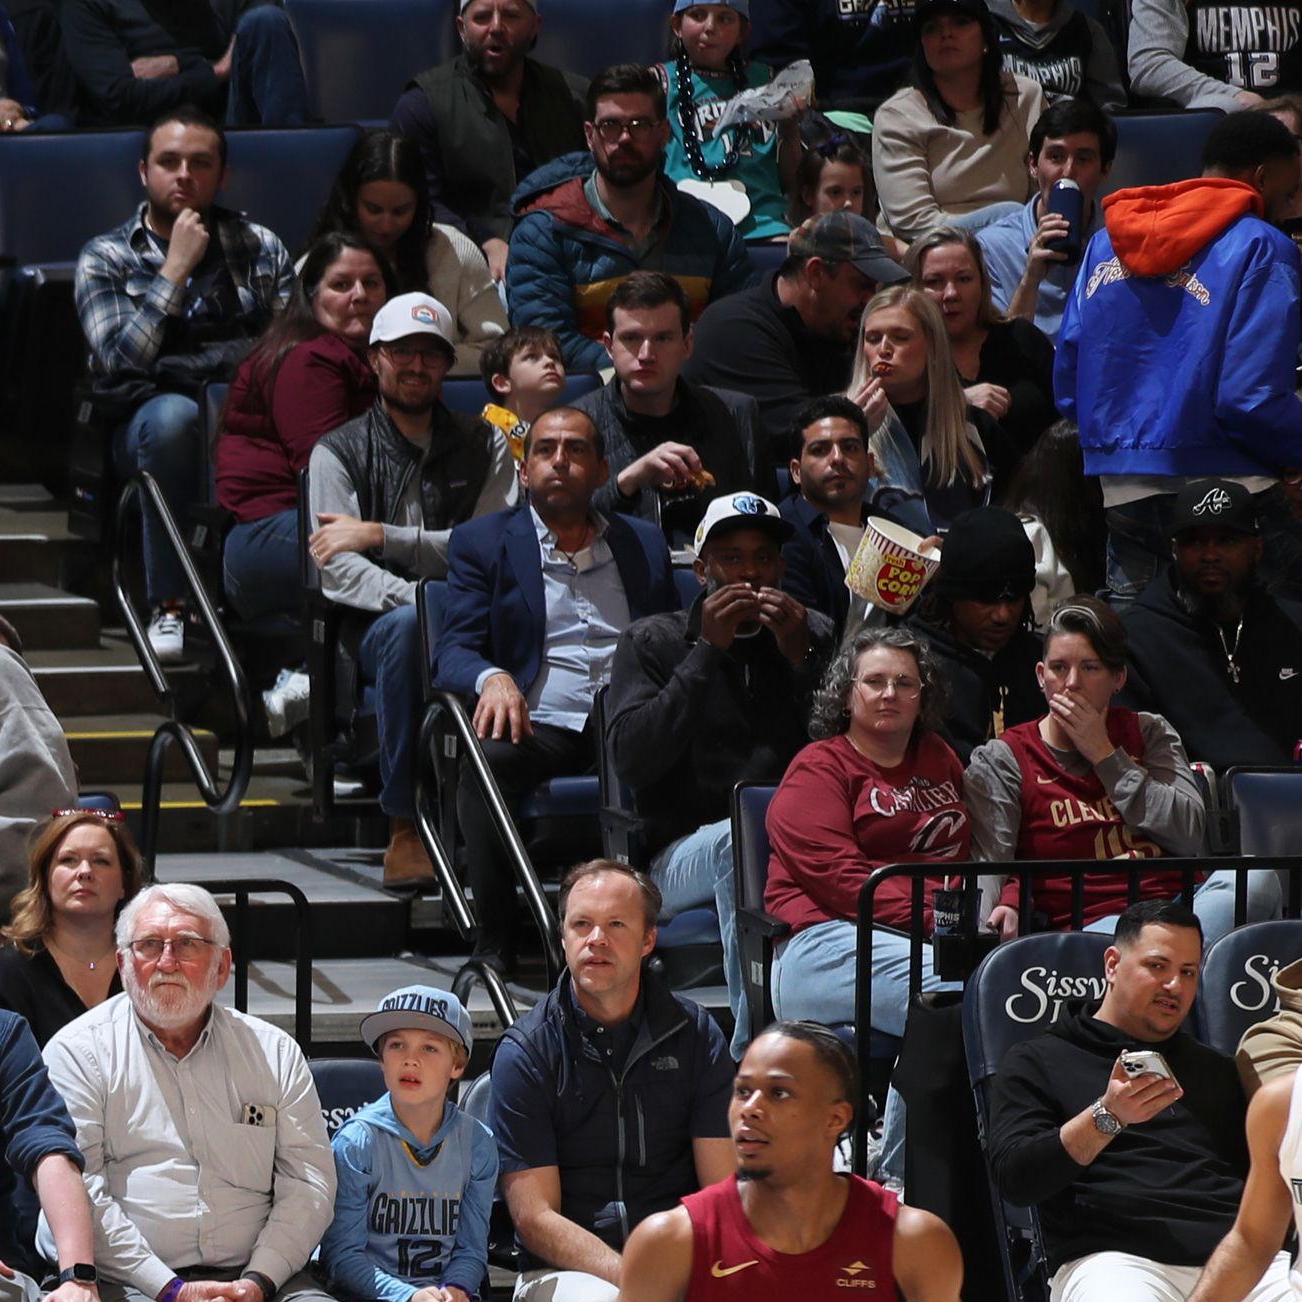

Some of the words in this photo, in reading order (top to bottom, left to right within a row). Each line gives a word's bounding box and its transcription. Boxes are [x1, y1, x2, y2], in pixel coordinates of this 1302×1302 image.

[1197, 7, 1300, 52] MEMPHIS
[1225, 52, 1279, 88] 12
[877, 579, 920, 597] CORN
[888, 567, 921, 583] POP
[396, 1238, 444, 1278] 12
[836, 1277, 876, 1288] CLIFFS
